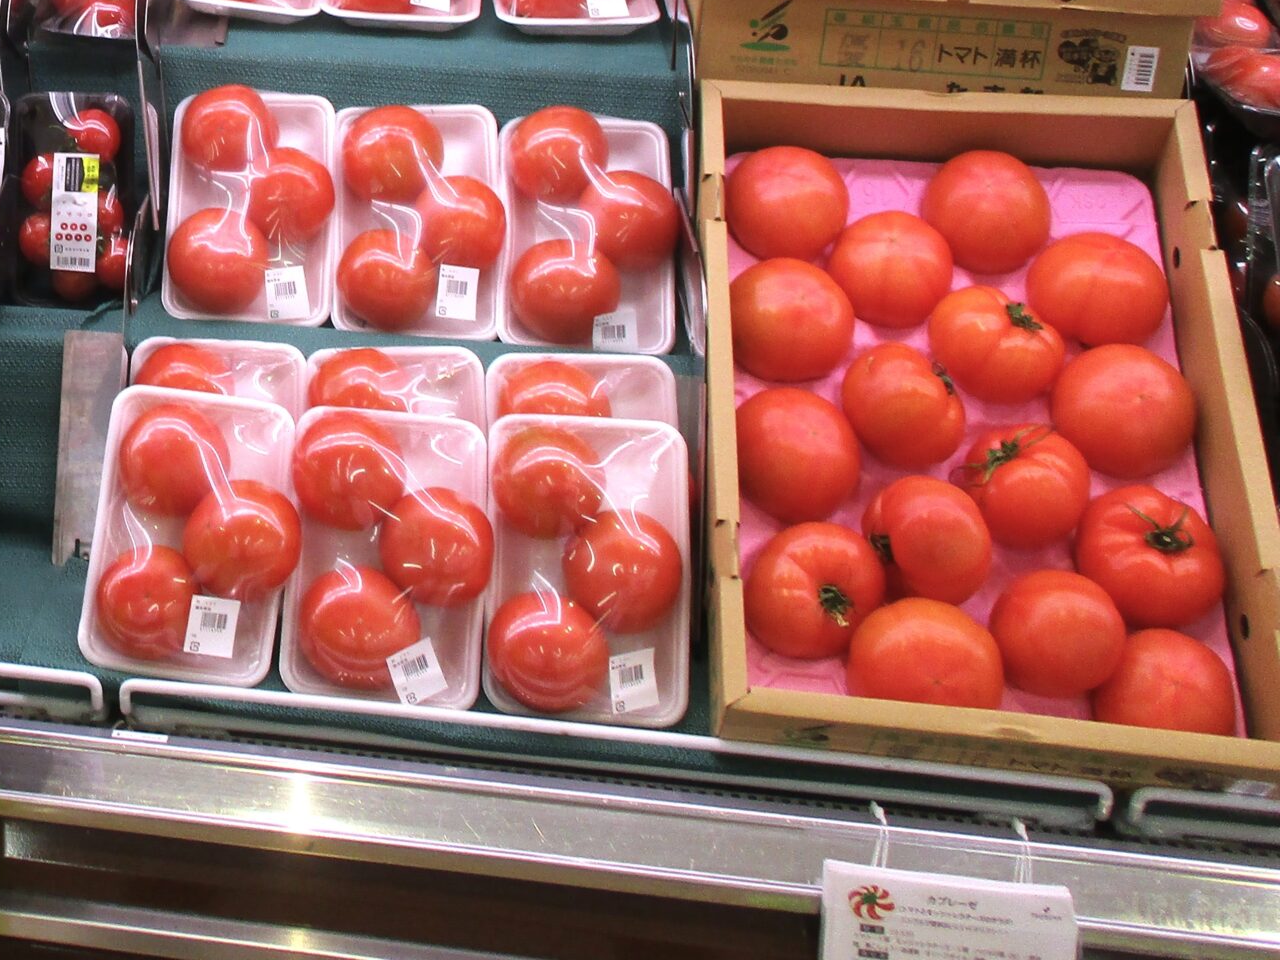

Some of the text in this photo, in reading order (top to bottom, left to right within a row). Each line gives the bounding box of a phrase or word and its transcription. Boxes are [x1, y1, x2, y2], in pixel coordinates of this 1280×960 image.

[937, 43, 989, 65] トマト
[993, 48, 1042, 70] 満杯
